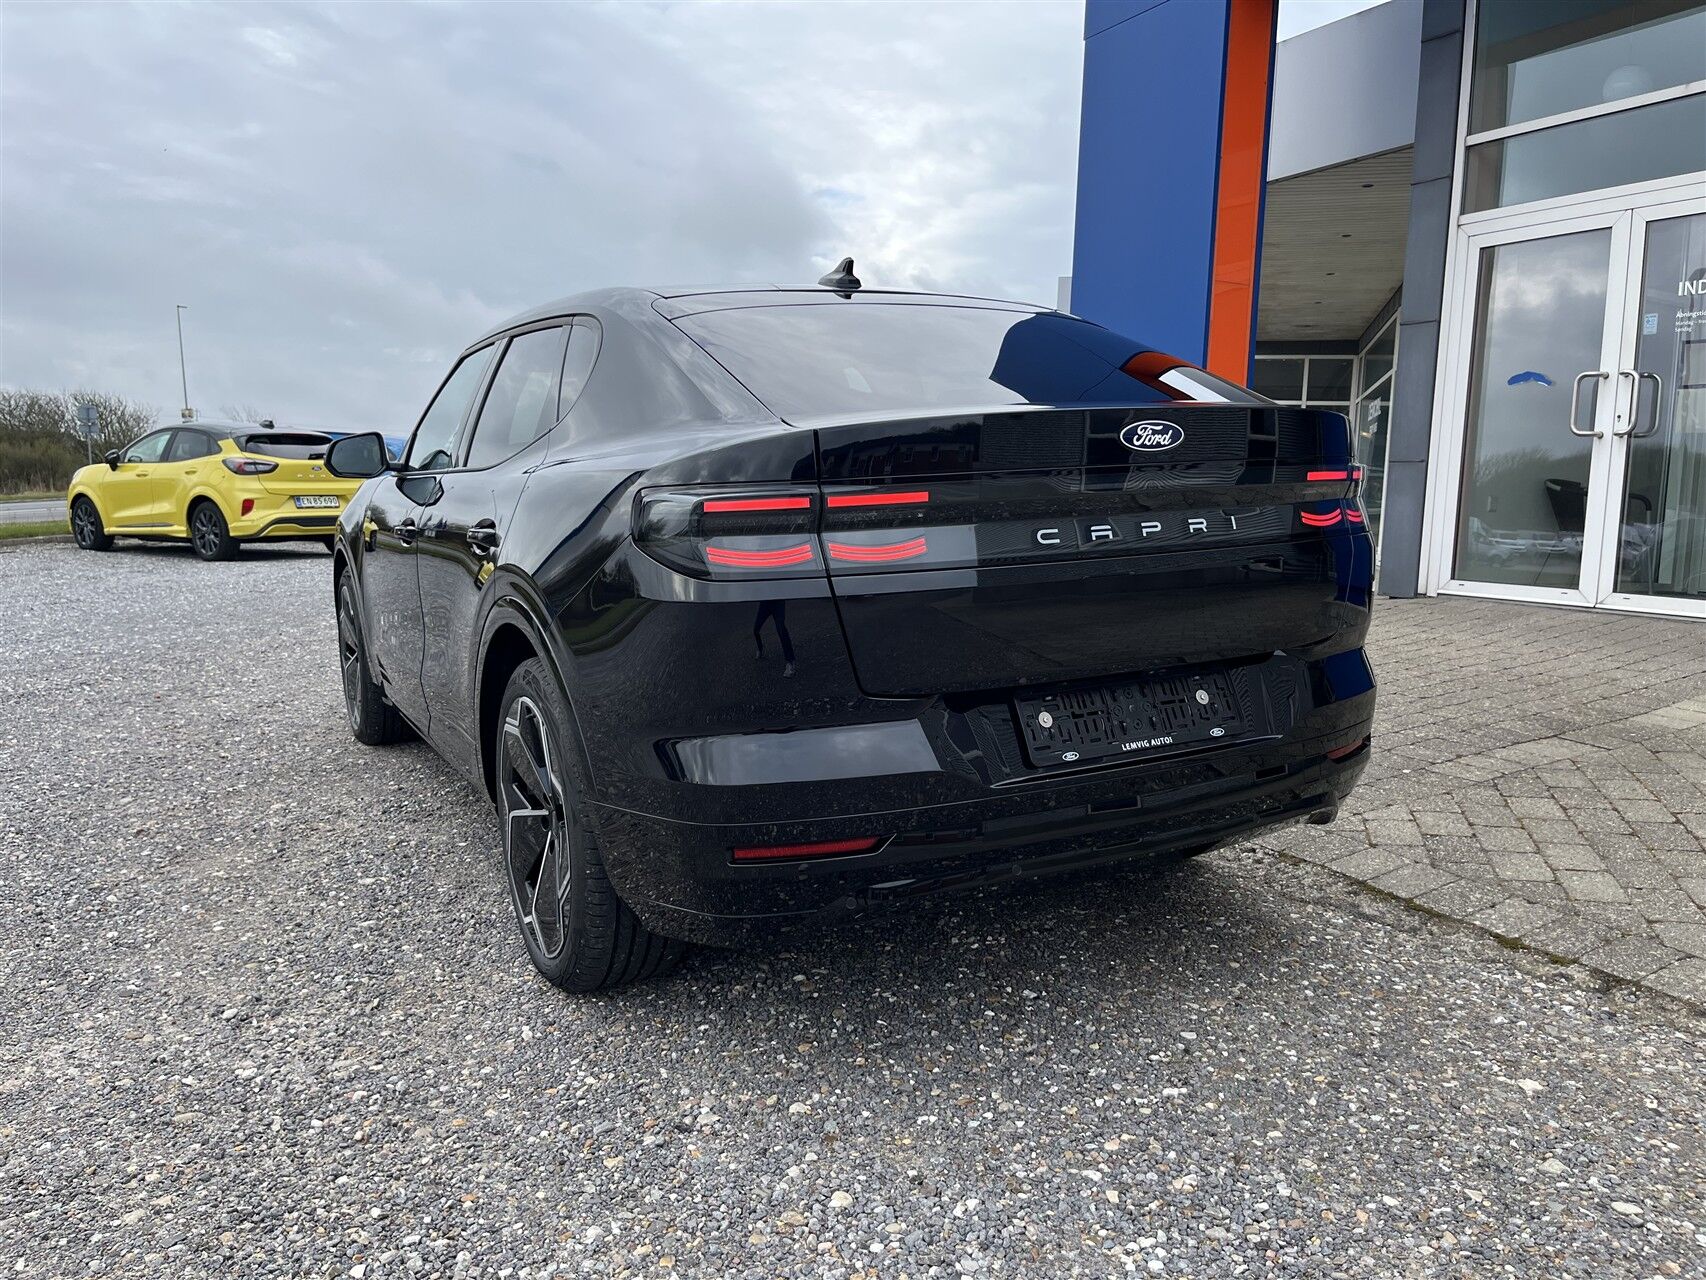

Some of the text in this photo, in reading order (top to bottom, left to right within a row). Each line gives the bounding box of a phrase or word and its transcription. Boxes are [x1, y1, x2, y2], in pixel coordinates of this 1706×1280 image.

[1678, 279, 1706, 296] IND
[1131, 423, 1174, 447] Ford
[1036, 515, 1237, 545] CAPRI
[1121, 739, 1150, 751] LEMVIG
